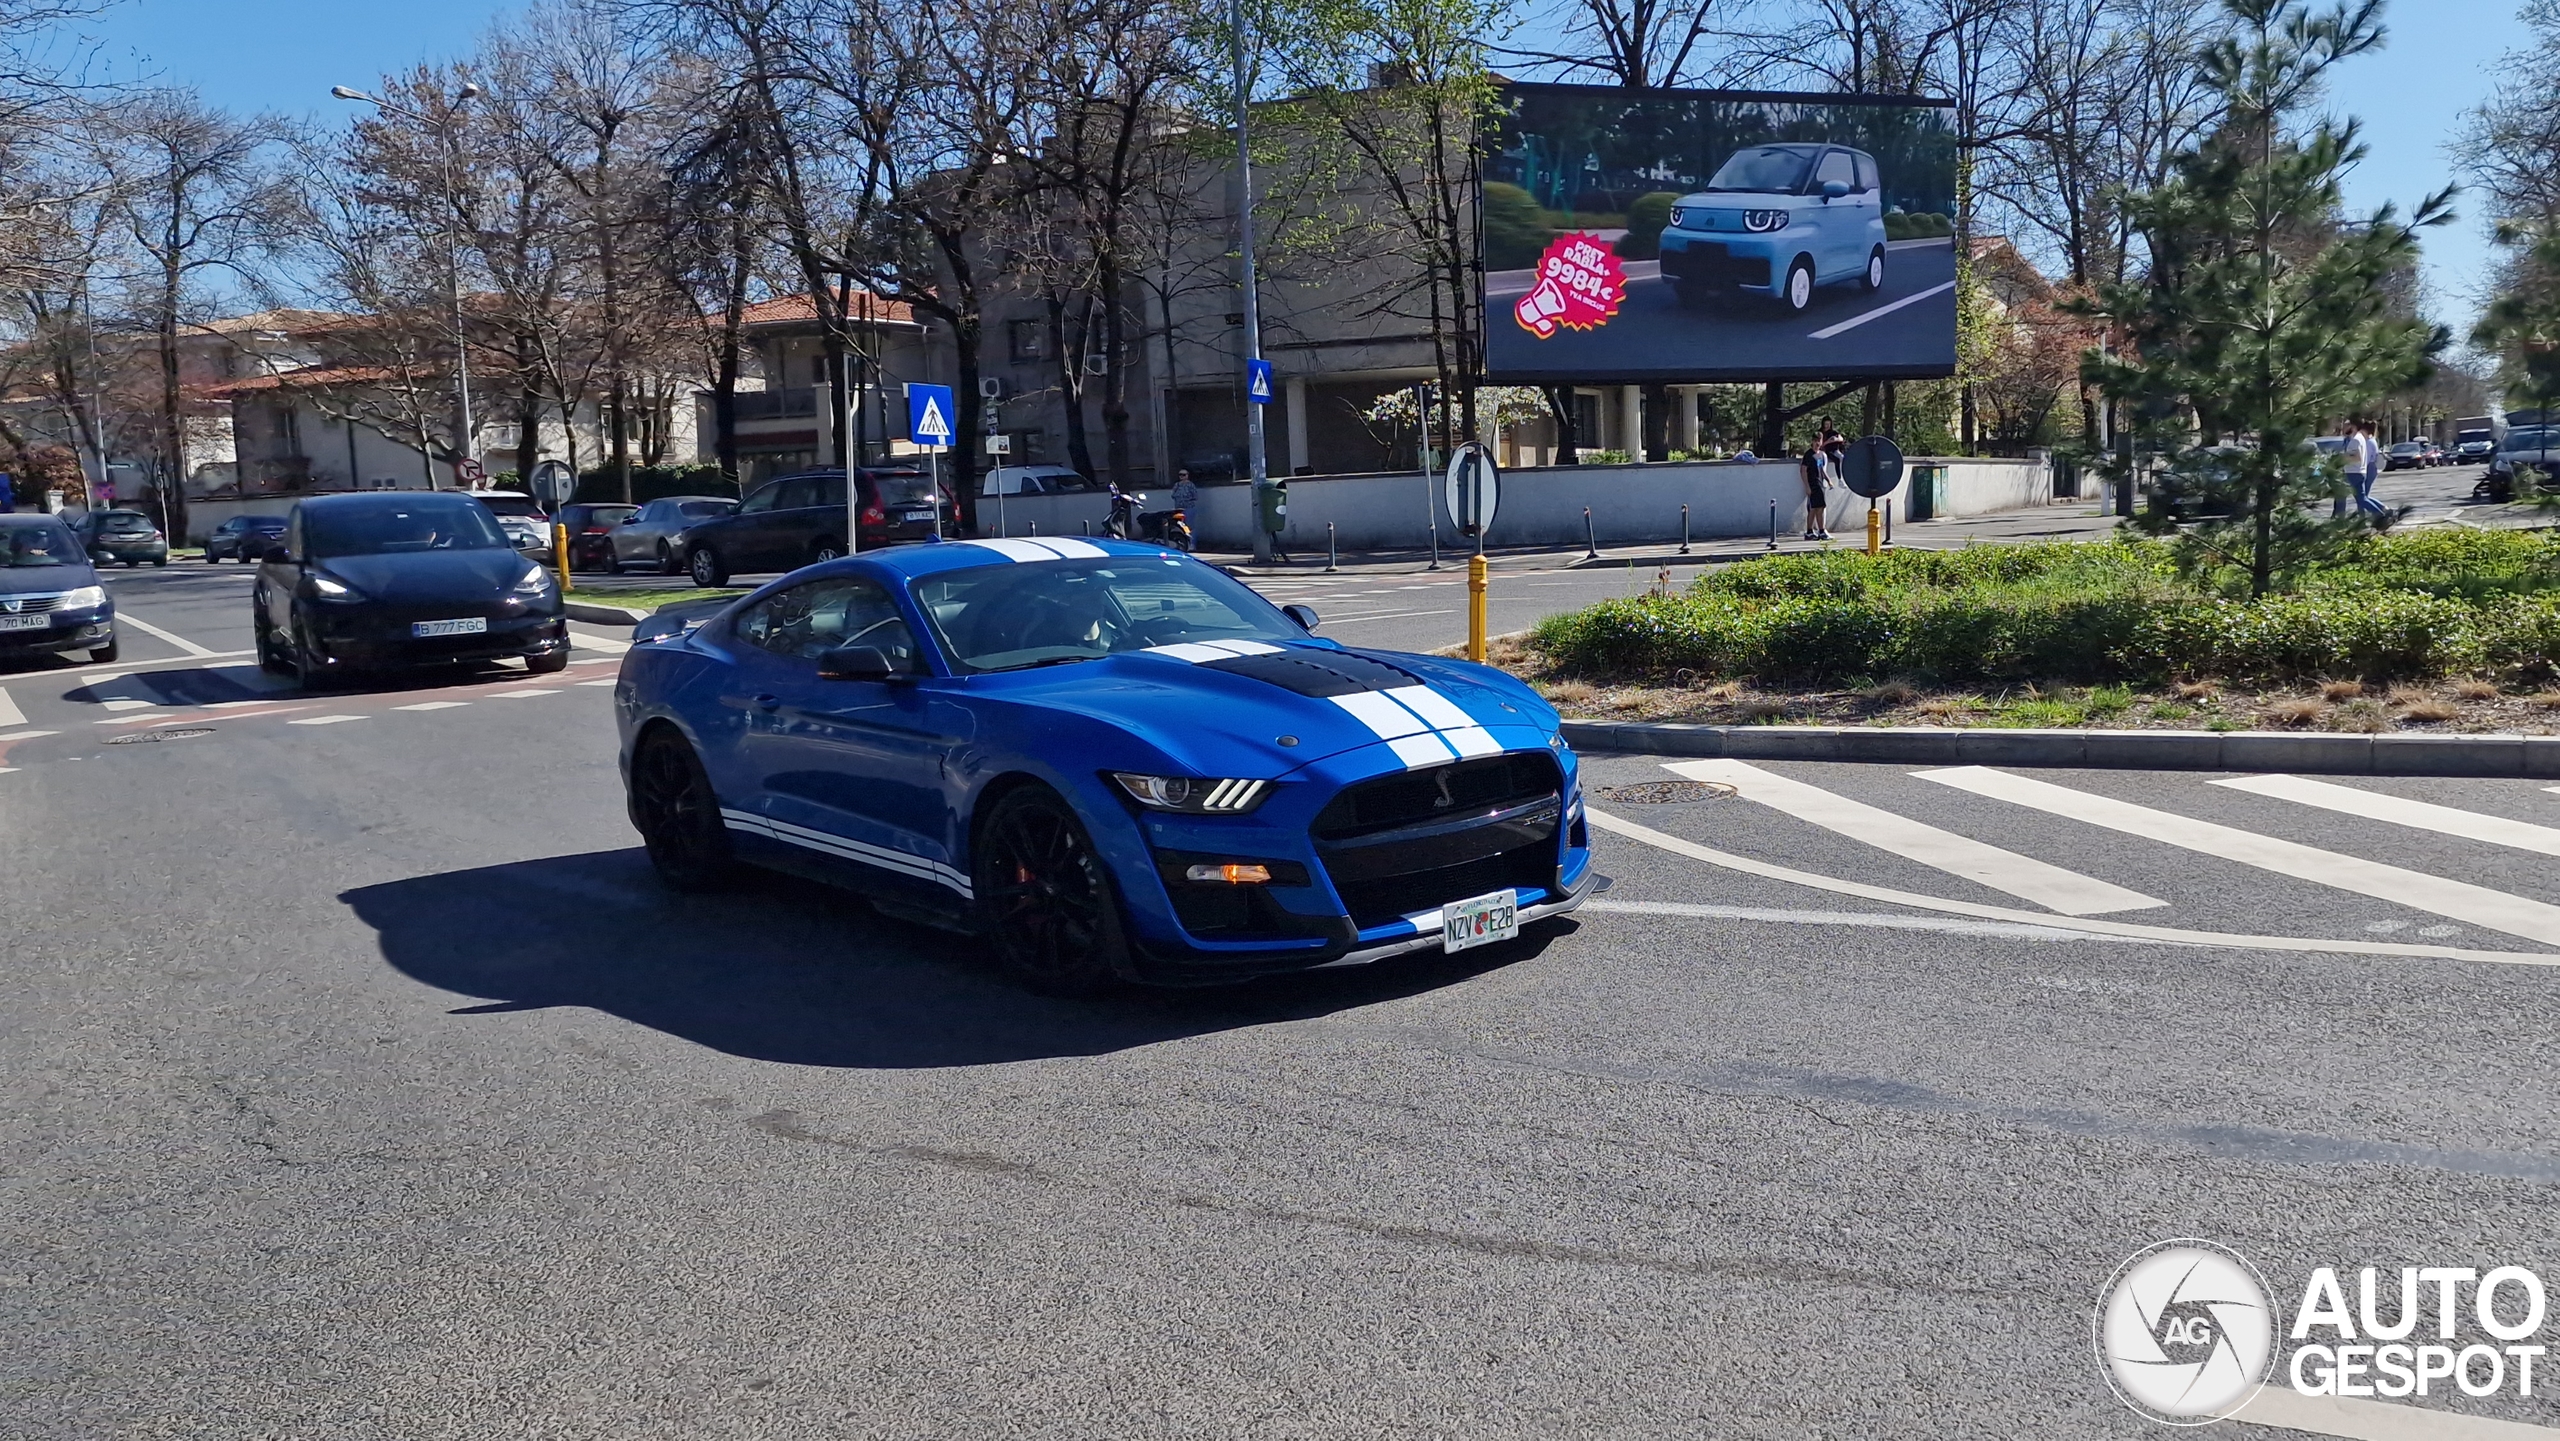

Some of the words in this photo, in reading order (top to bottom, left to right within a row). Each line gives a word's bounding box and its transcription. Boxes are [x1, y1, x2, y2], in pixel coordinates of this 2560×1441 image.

[1575, 241, 1606, 262] PRET
[1545, 257, 1614, 301] 9984€
[1569, 290, 1582, 302] TVA
[4, 618, 18, 628] 70
[22, 616, 44, 627] MAG
[420, 624, 430, 635] B
[434, 622, 455, 634] 777
[458, 620, 484, 632] FGC
[1447, 914, 1473, 943] NZV
[1489, 905, 1514, 932] E28
